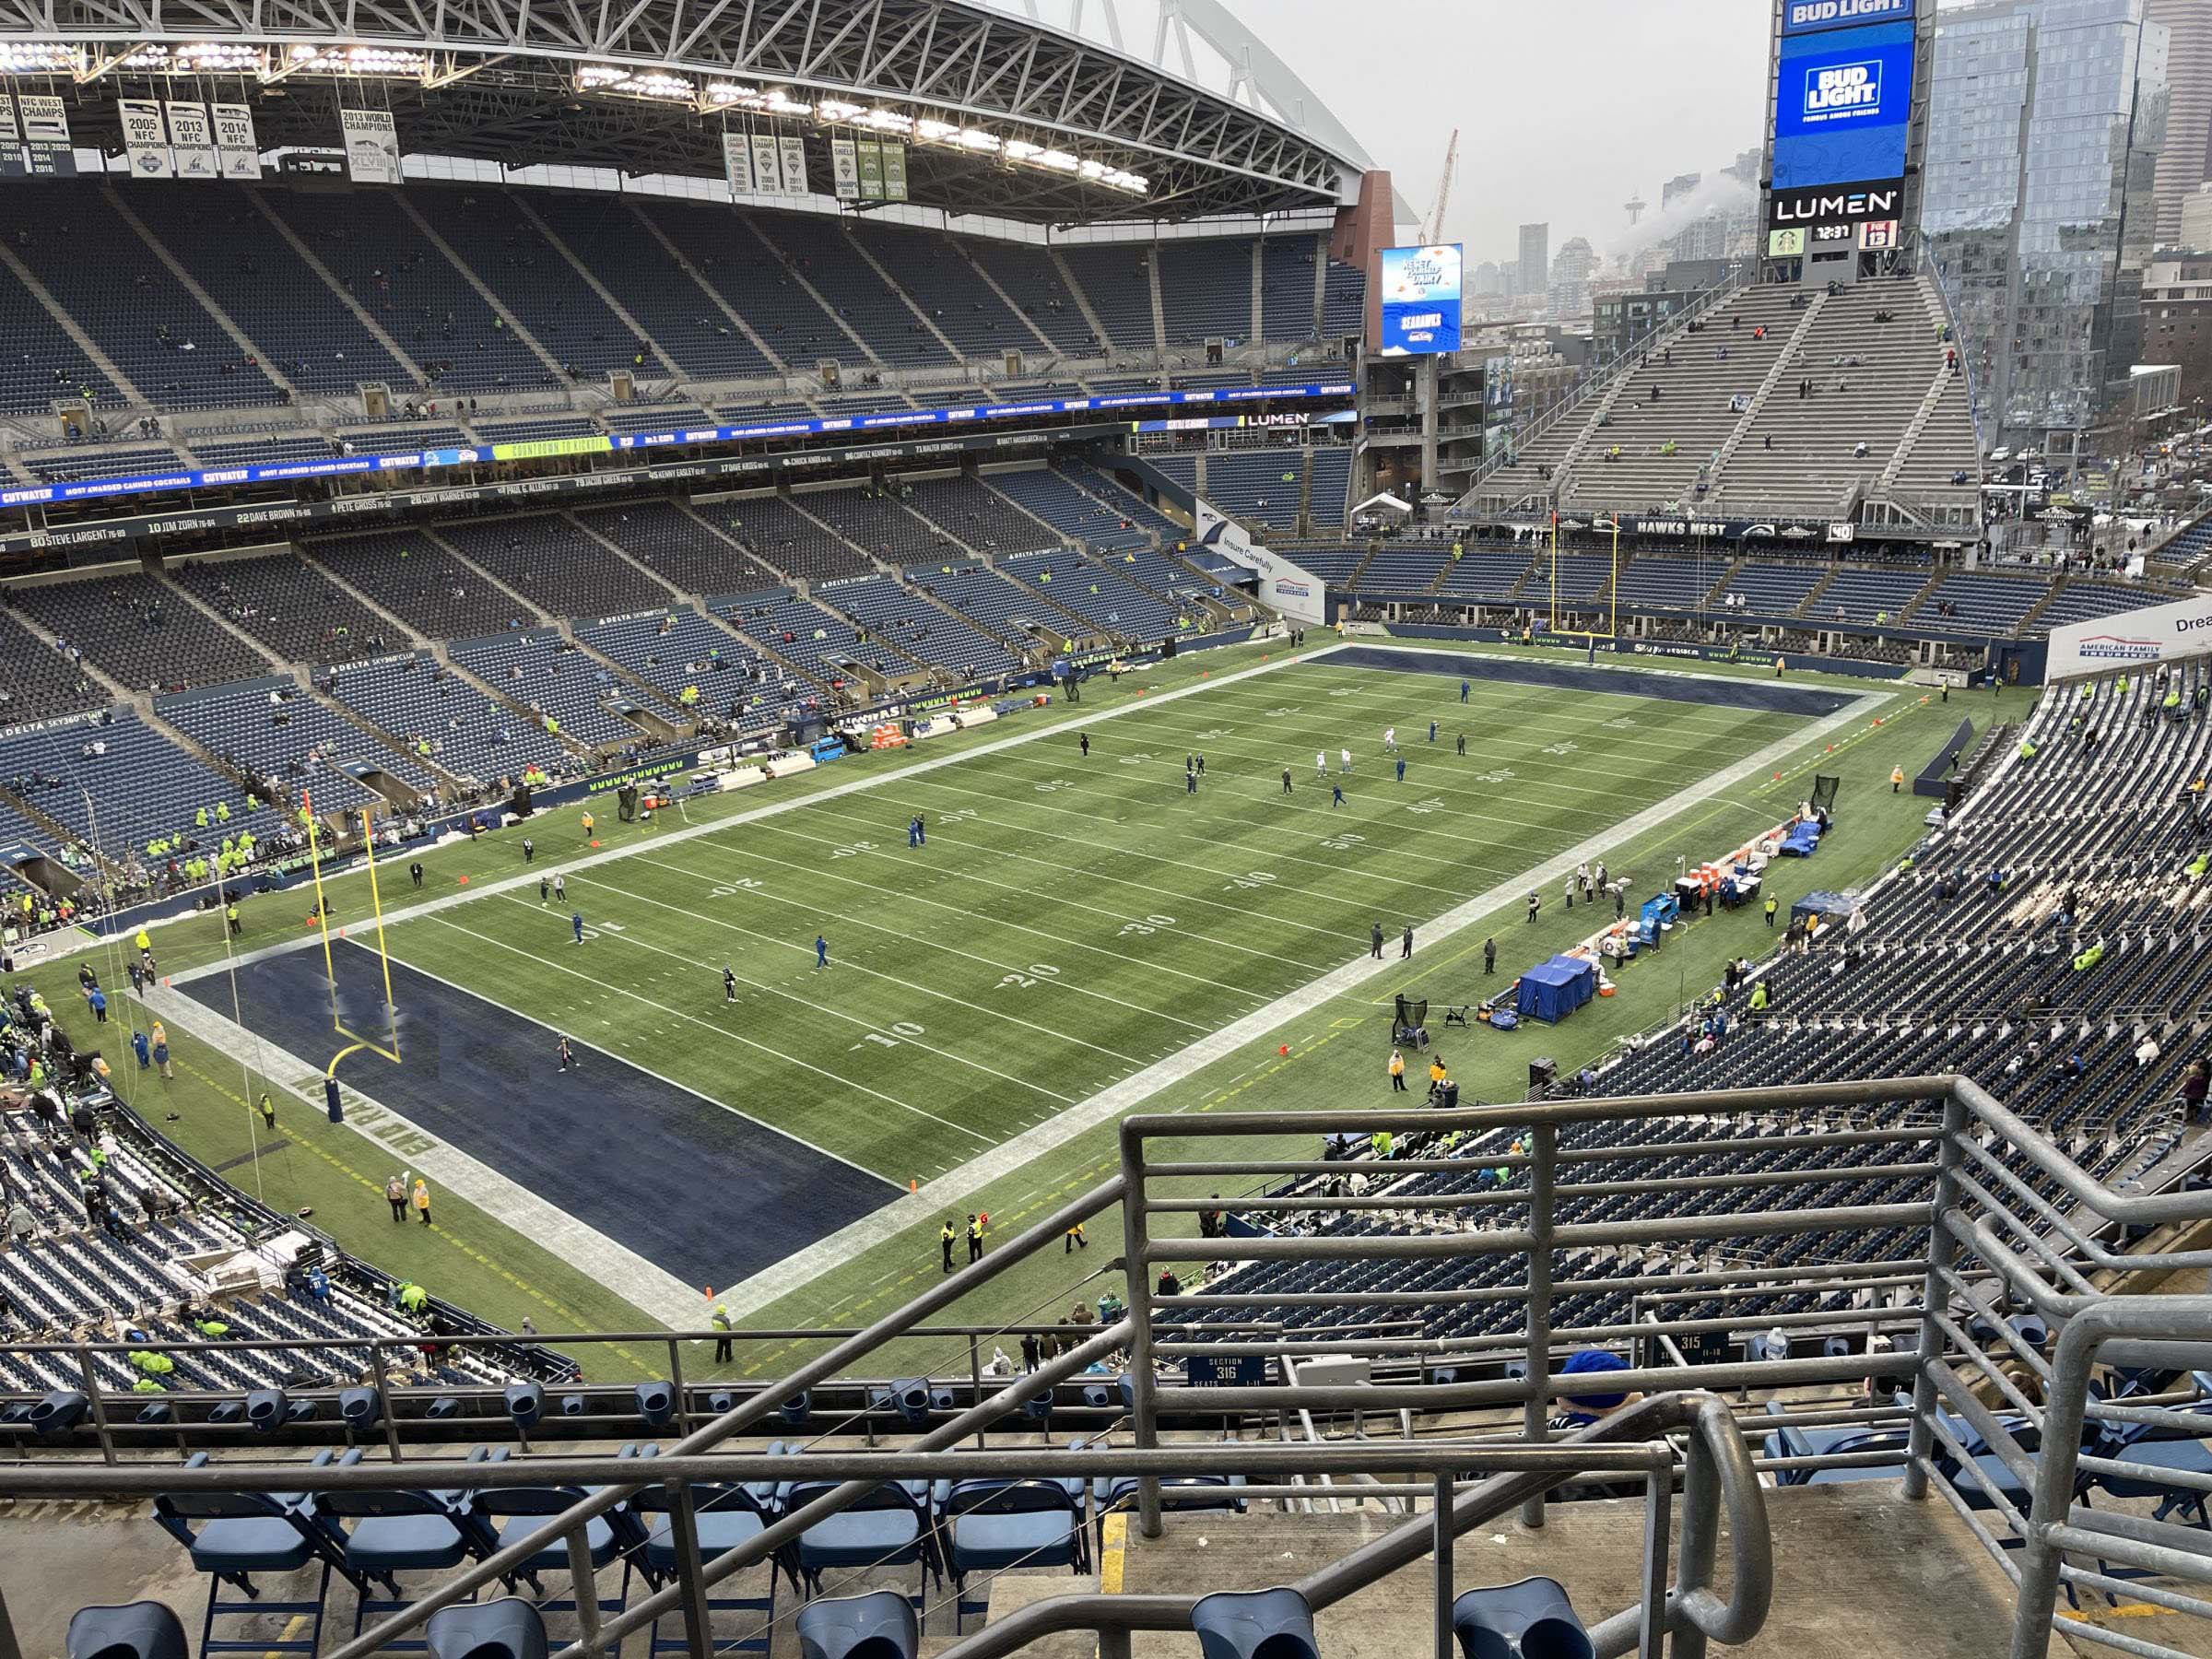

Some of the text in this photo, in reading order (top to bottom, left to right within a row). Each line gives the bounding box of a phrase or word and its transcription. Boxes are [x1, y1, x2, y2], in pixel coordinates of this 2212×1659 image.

[1793, 2, 1837, 23] BUD
[1818, 66, 1867, 89] BUD
[1808, 83, 1876, 109] LIGHT
[39, 99, 62, 107] WEST
[22, 107, 64, 118] CHAMPS
[343, 112, 391, 123] 2013 WORLD
[129, 118, 157, 130] 2005
[175, 121, 202, 132] 2013
[221, 123, 247, 134] 2014
[345, 122, 393, 131] CHAMPIONS
[135, 131, 155, 140] NFC
[182, 133, 201, 142] NFC
[227, 135, 245, 143] NFC
[127, 141, 167, 149] CHAMPIONS
[3, 153, 22, 161] 2010
[1777, 191, 1892, 220] LUMEN
[1818, 225, 1849, 240] 12:37
[1869, 231, 1886, 246] 13
[1248, 413, 1308, 426] LUMEN
[513, 438, 604, 455] COUNTDOWN TO KICKOFF
[658, 468, 676, 478] KENNY
[677, 466, 694, 477] EASLEY
[2, 488, 53, 503] CUTWATER
[88, 485, 122, 494] AWARDED
[124, 481, 152, 489] CANNED
[154, 477, 191, 487] COCKTAILS
[203, 470, 248, 483] CUTWATER
[380, 455, 419, 467] CUTWATER
[603, 473, 620, 485] GREEN
[507, 484, 522, 494] PAUL
[529, 481, 546, 492] ALLEN
[422, 493, 438, 504] CURT
[440, 490, 465, 502] WARNER
[336, 501, 353, 512] PETE
[355, 499, 377, 512] GROSS
[237, 512, 250, 524] 22
[250, 511, 268, 522] DAVE
[269, 508, 295, 520] BROWN
[148, 524, 161, 533] 10
[161, 521, 176, 532] JIM
[177, 519, 197, 531] ZORN
[1637, 522, 1725, 536] HAWKS NEST
[1832, 526, 1849, 539] 40
[30, 536, 46, 547] 80
[46, 533, 71, 547] STEVE
[72, 529, 107, 543] LARGENT
[1015, 550, 1032, 559] DELTA
[1223, 537, 1274, 573] Insure Carefully
[606, 614, 631, 623] DELTA
[339, 660, 369, 671] DELTA
[6, 723, 44, 736] DELTA
[1320, 833, 1365, 850] 50
[1233, 871, 1277, 888] 40
[712, 878, 762, 895] 20
[1124, 914, 1176, 935] 30
[1002, 964, 1060, 988] 20
[865, 1022, 924, 1048] 10
[1681, 1336, 1700, 1349] 315
[1217, 1367, 1236, 1379] 316
